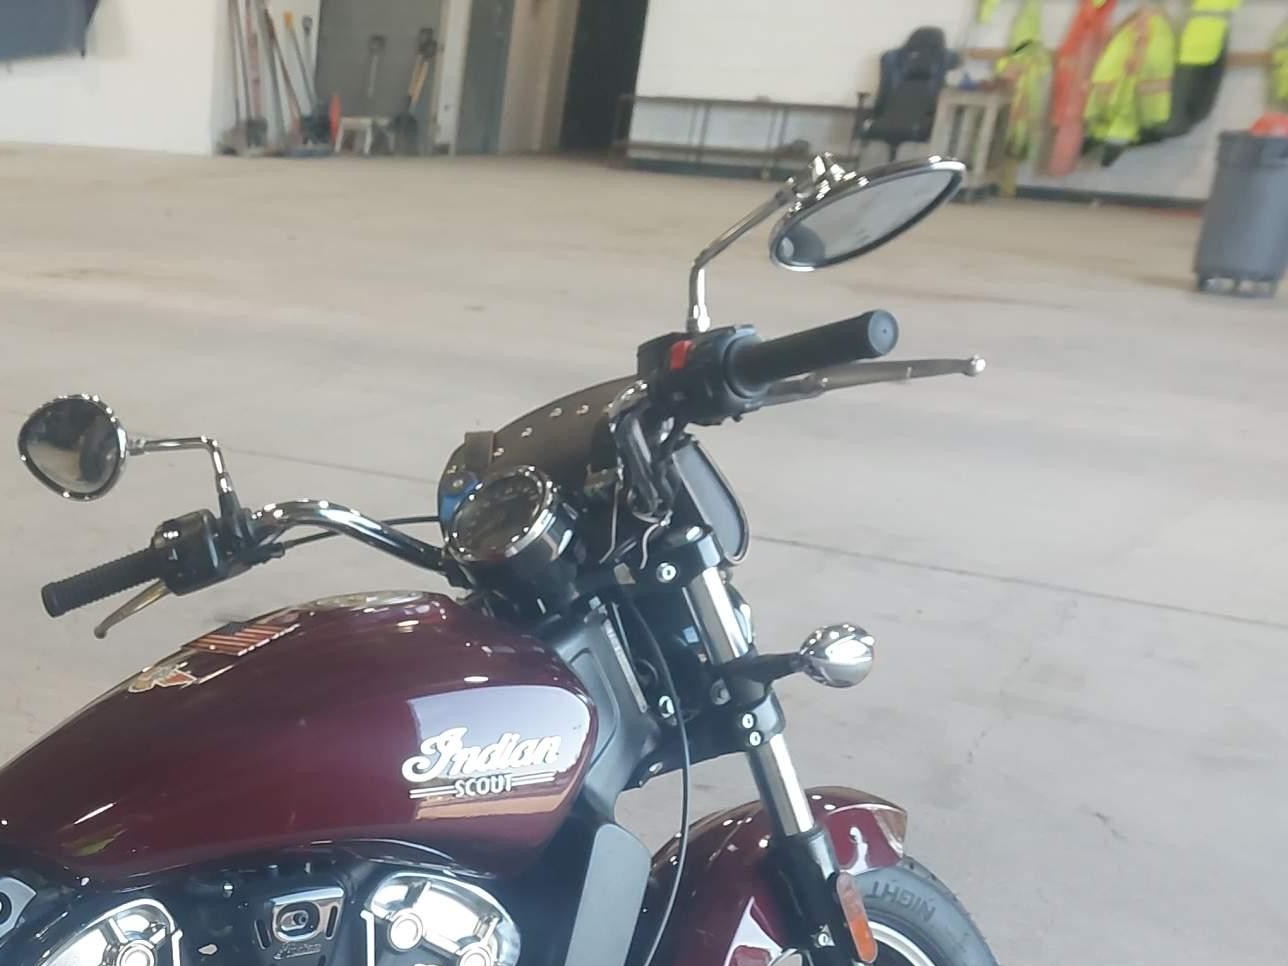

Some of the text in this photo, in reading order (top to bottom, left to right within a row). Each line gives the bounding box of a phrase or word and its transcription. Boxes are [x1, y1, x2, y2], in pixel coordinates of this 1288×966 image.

[402, 727, 562, 783] Indian
[454, 774, 513, 798] SCOUT
[863, 880, 936, 922] NIGHT
